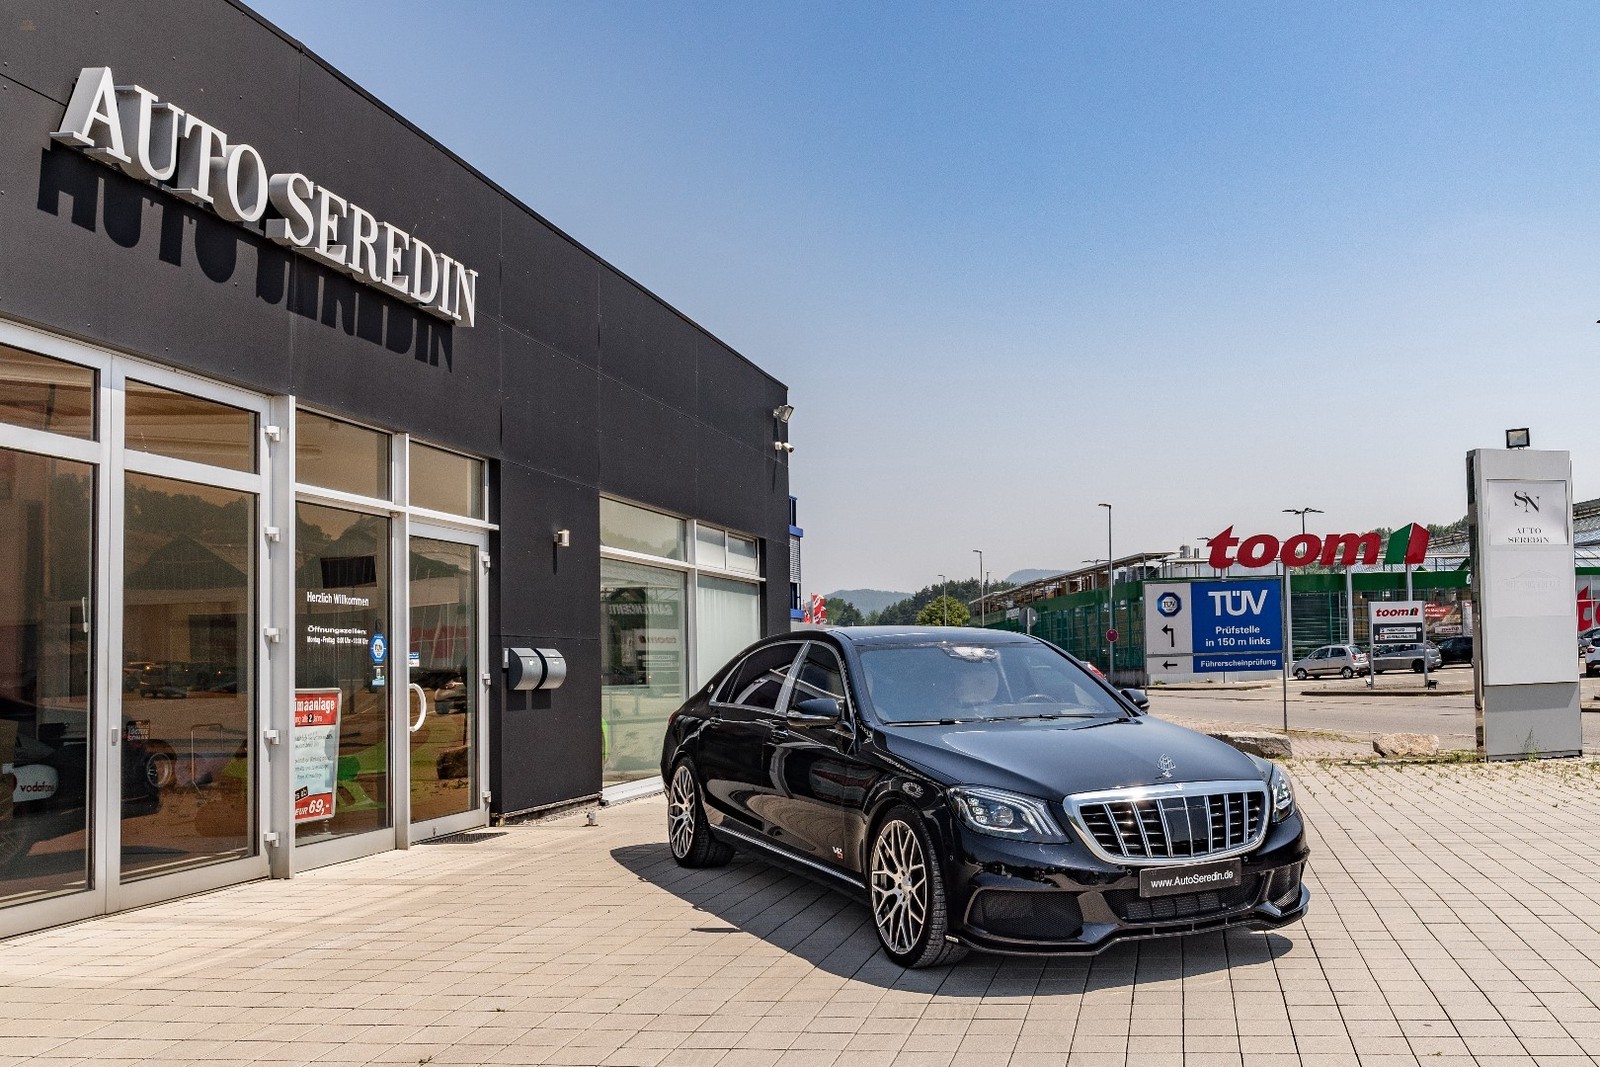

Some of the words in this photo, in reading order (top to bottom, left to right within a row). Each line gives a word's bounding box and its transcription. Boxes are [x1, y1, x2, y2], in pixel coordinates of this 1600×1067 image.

[51, 67, 269, 223] AUTO
[267, 172, 479, 327] SEREDIN
[1207, 524, 1382, 569] toom
[306, 591, 333, 604] Herzlich
[333, 594, 369, 606] Willkommen
[1207, 590, 1268, 617] TÜV
[1376, 608, 1409, 617] toom
[1215, 625, 1260, 634] Prüfstelle
[1205, 639, 1215, 647] in
[1217, 637, 1236, 646] 150
[1237, 638, 1247, 646] m
[1248, 636, 1271, 645] links
[1200, 659, 1277, 668] Führerscheinprüfung
[1150, 870, 1234, 888] www.AutoSeredin.de
